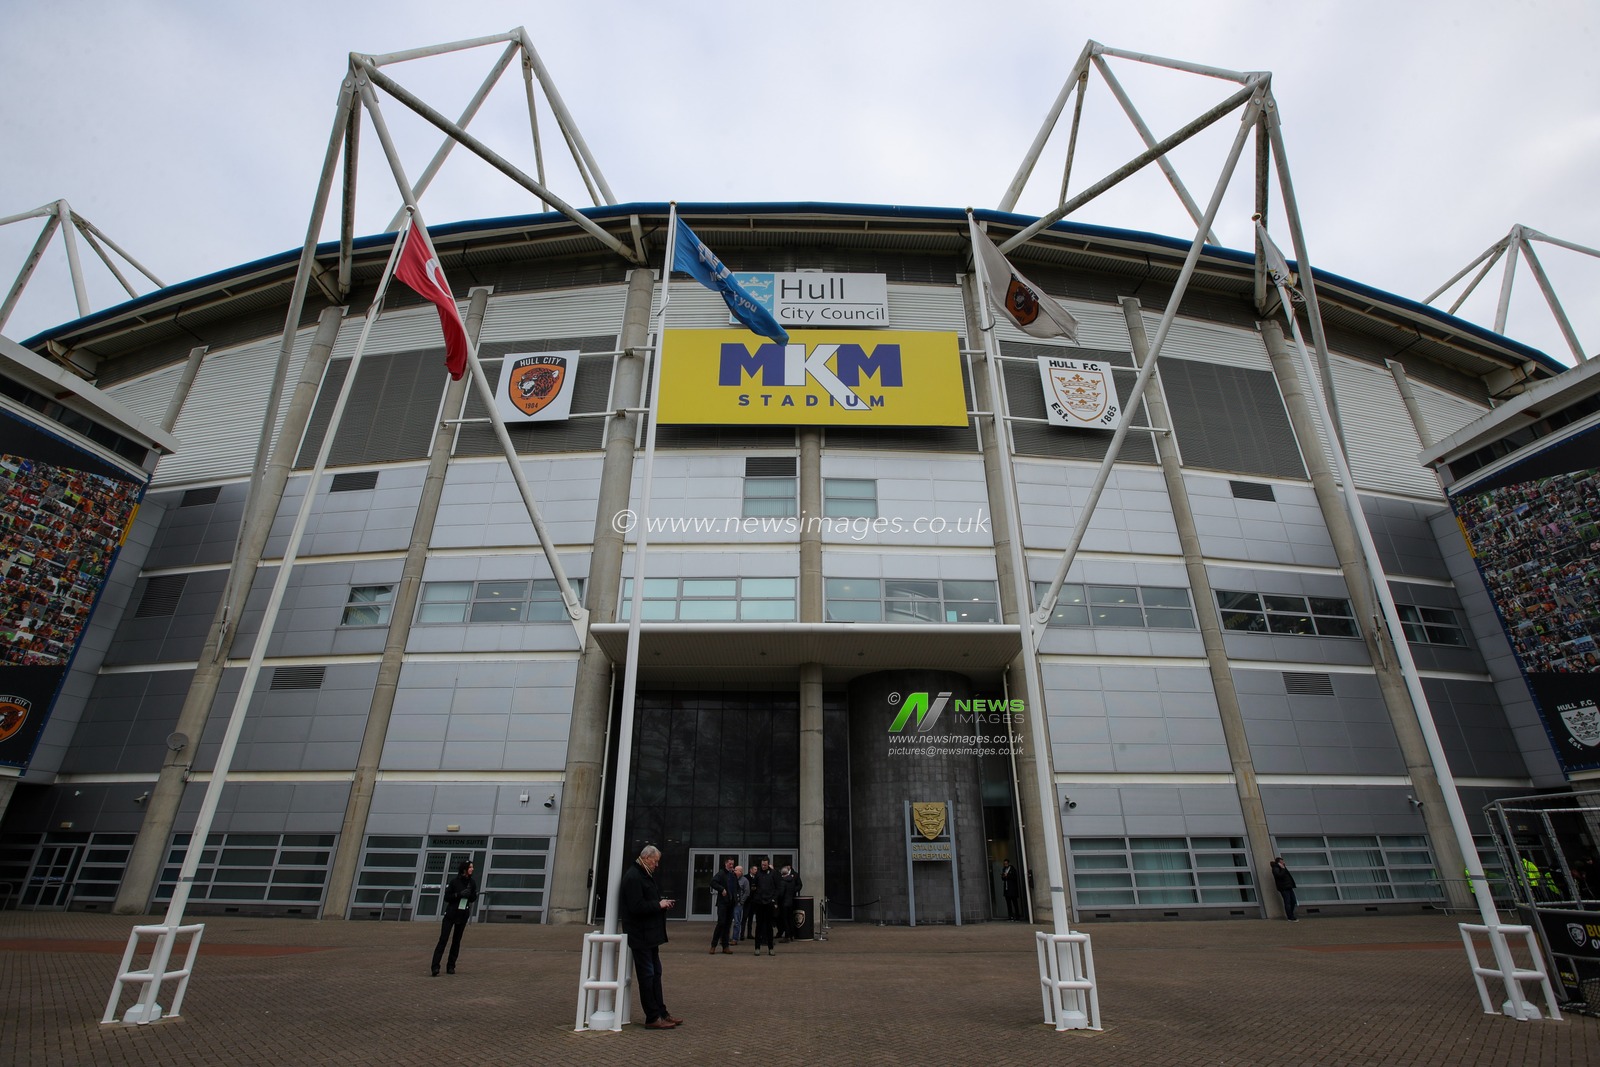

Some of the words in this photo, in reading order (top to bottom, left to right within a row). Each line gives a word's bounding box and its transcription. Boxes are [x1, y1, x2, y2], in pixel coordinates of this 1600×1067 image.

[780, 277, 844, 300] Hull
[738, 297, 758, 313] you
[780, 306, 814, 322] City
[820, 306, 885, 320] Council
[520, 357, 540, 367] HULL
[542, 356, 561, 365] CITY
[1049, 359, 1077, 369] HULL
[1082, 362, 1101, 371] F.C.
[718, 342, 903, 410] MKM
[738, 394, 885, 408] STADIUM
[1100, 405, 1117, 425] 1865
[14, 698, 28, 707] CITY
[1556, 703, 1577, 711] HULL
[1580, 699, 1596, 707] F.C.
[911, 852, 952, 860] RECEPTION
